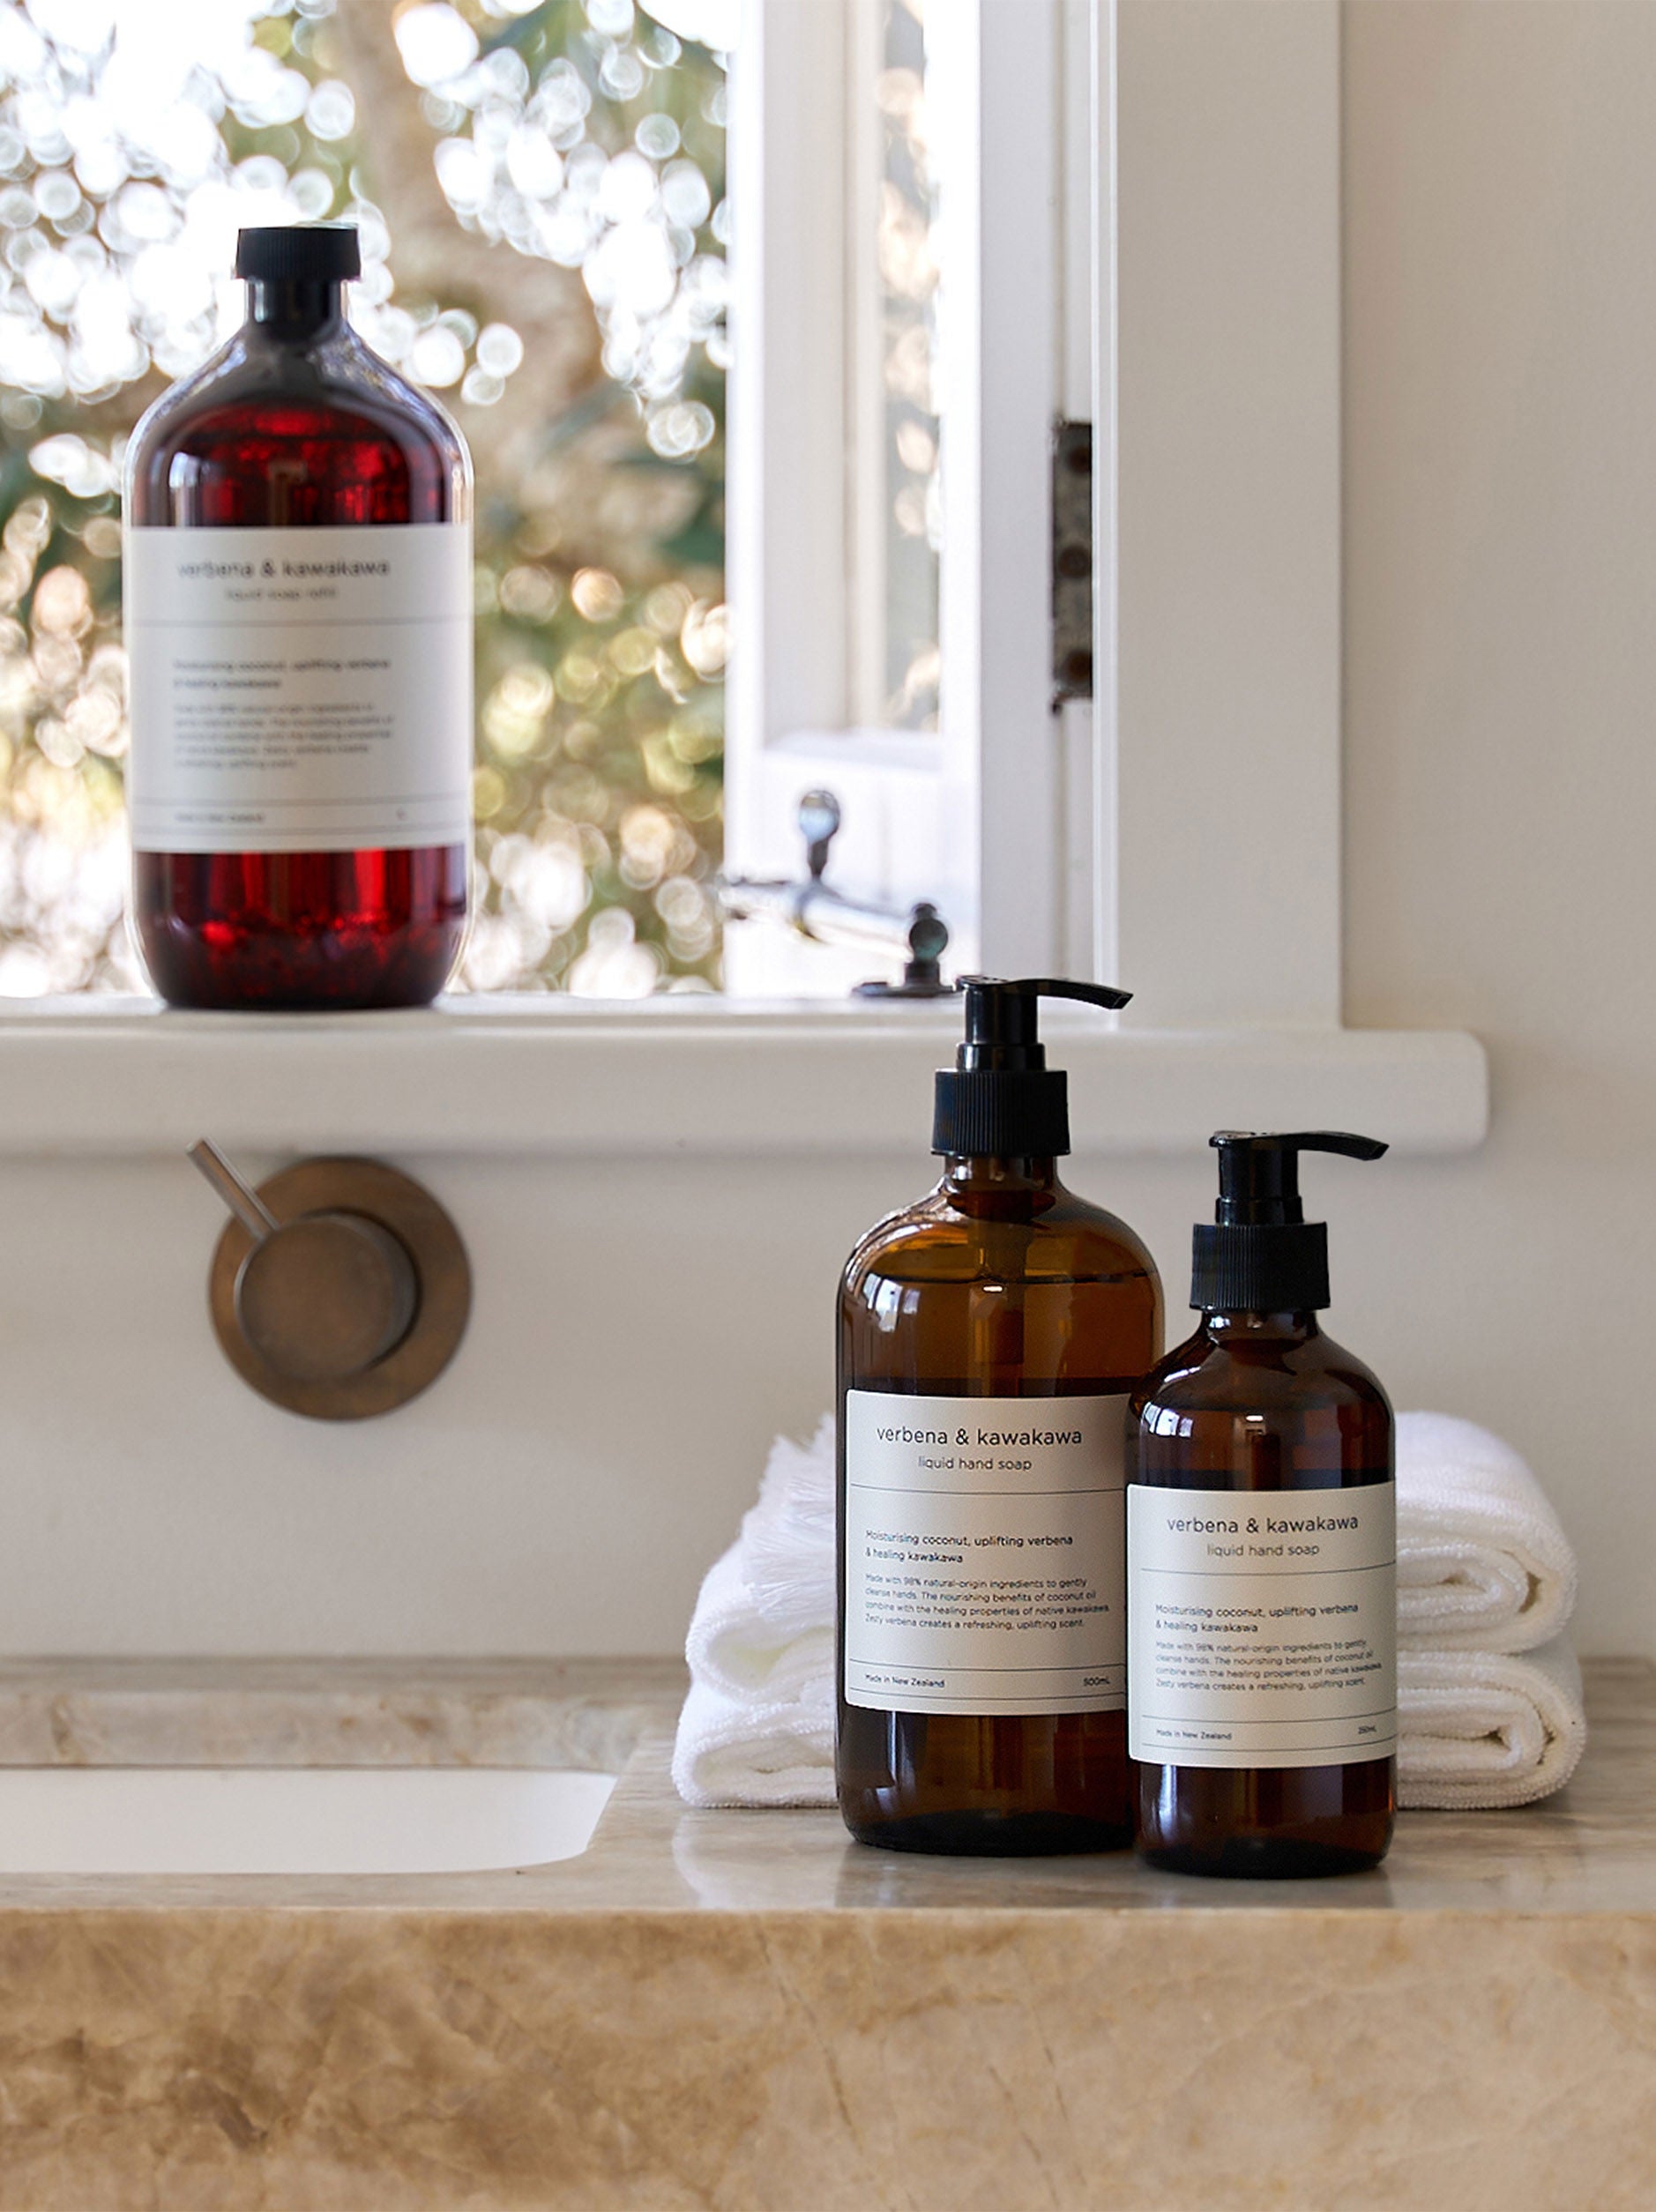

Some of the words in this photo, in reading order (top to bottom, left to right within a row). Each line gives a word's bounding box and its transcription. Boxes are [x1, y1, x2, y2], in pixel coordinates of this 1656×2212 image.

[876, 1426, 948, 1444] verbena
[955, 1428, 969, 1445] &
[977, 1428, 1082, 1446] kawakawa
[919, 1456, 954, 1470] liquid
[959, 1458, 993, 1471] hand
[998, 1459, 1032, 1471] soap
[1167, 1516, 1238, 1533] verbena
[1246, 1517, 1260, 1533] &
[1266, 1516, 1359, 1533] kawakawa
[865, 1530, 920, 1545] Moisturising
[922, 1536, 971, 1547] coconut,
[974, 1536, 1024, 1548] uplifting
[1027, 1536, 1073, 1546] verbena
[865, 1546, 871, 1558] &
[873, 1548, 906, 1563] healing
[907, 1552, 963, 1563] kawakawa
[1207, 1543, 1243, 1558] liquid
[1249, 1544, 1283, 1556] hand
[1288, 1545, 1320, 1556] soap
[921, 1591, 937, 1601] The
[940, 1592, 989, 1604] nourishing
[993, 1593, 1031, 1603] benefits
[1034, 1592, 1045, 1602] of
[1047, 1591, 1084, 1602] coconut
[1085, 1590, 1096, 1600] oil
[898, 1605, 914, 1613] with
[916, 1605, 931, 1614] the
[934, 1605, 967, 1617] healing
[970, 1606, 1020, 1618] properties
[1023, 1607, 1033, 1616] of
[1034, 1606, 1064, 1615] native
[1156, 1605, 1213, 1619] Moisturising
[1216, 1608, 1266, 1618] coconut,
[1269, 1606, 1317, 1618] uplifting
[1319, 1604, 1359, 1615] verbena
[885, 1616, 917, 1627] verbena
[919, 1619, 951, 1629] creates
[954, 1620, 961, 1629] a
[963, 1620, 1015, 1631] refreshing,
[1017, 1620, 1057, 1630] uplifting
[1156, 1620, 1162, 1628] &
[1164, 1620, 1198, 1634] healing
[1201, 1622, 1258, 1633] kawakawa
[865, 1672, 882, 1683] Made
[884, 1675, 891, 1684] in
[891, 1676, 909, 1685] New
[910, 1677, 945, 1688] Zealand
